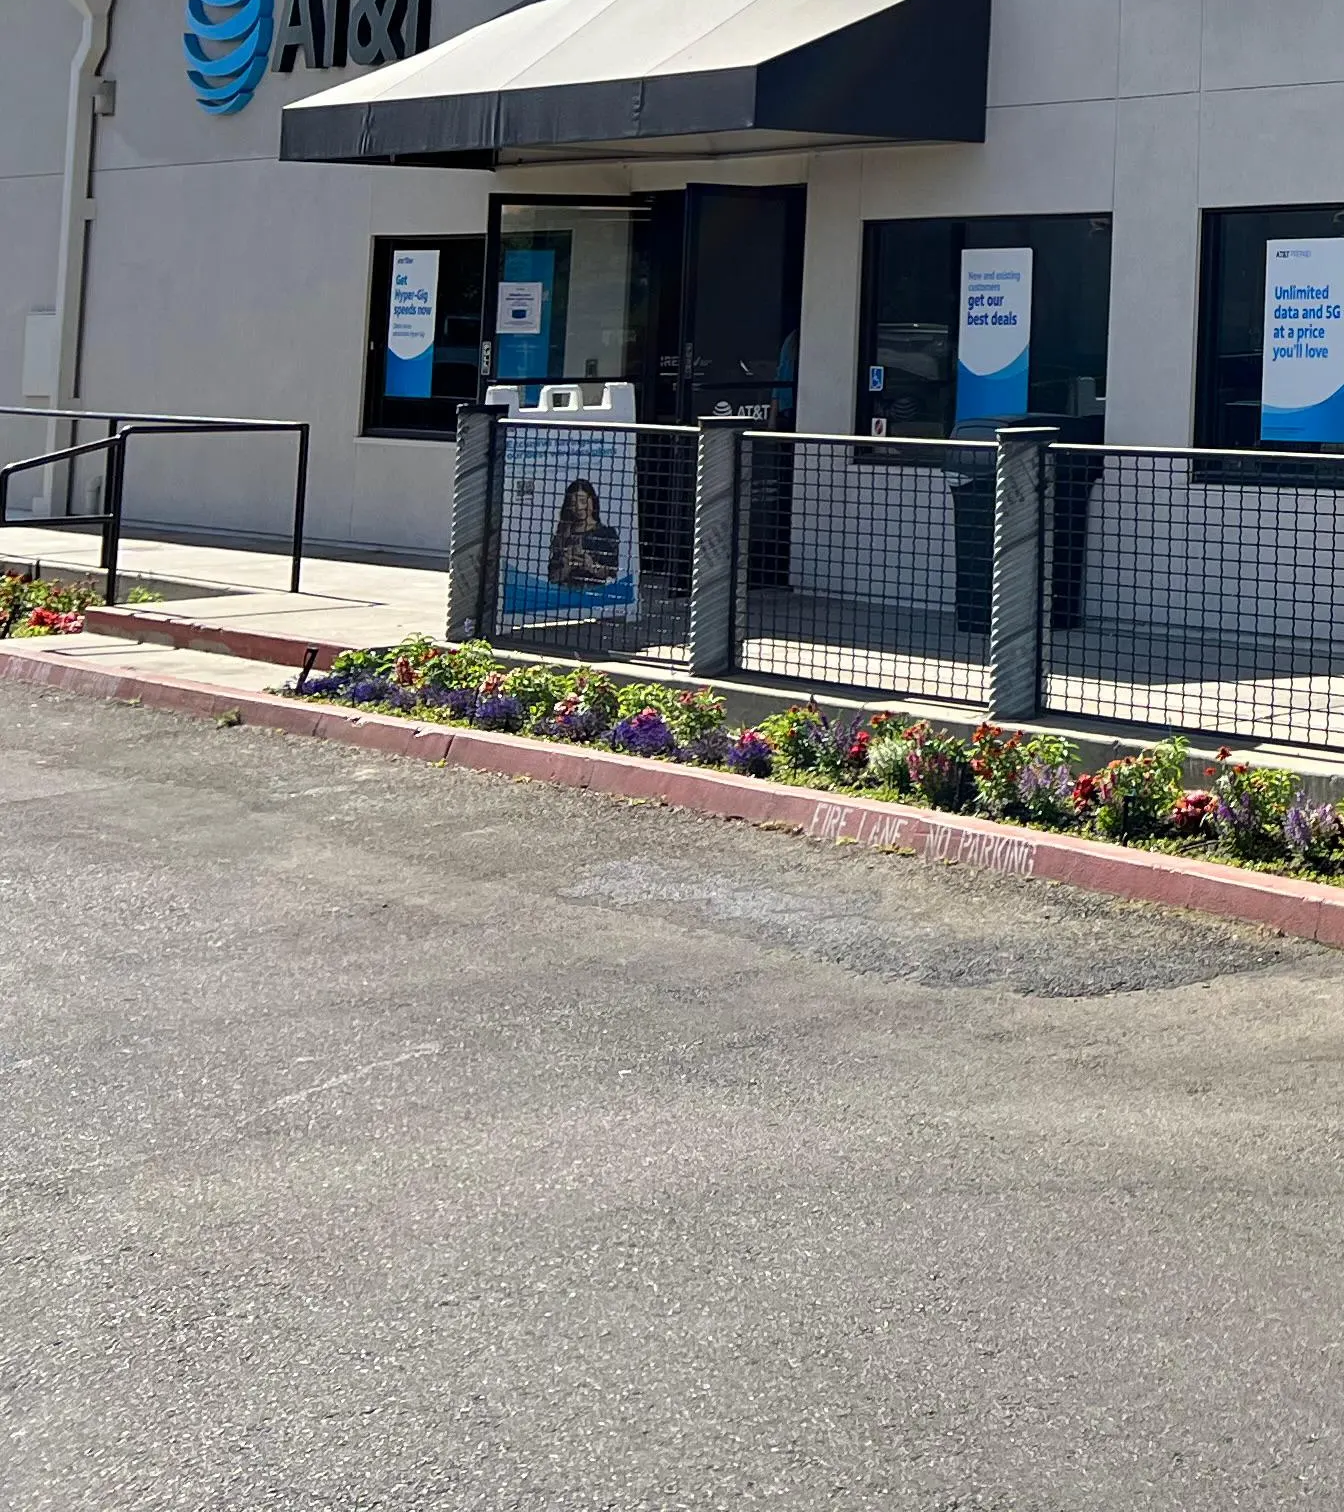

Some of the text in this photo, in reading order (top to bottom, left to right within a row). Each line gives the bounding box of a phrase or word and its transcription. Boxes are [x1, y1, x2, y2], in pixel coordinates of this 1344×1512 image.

[1274, 284, 1329, 300] Unlimited
[968, 293, 1005, 310] get our
[967, 310, 1018, 326] best deals
[1273, 304, 1341, 319] data and 5G
[1273, 323, 1325, 343] at a price
[1272, 343, 1329, 362] you'll love
[737, 404, 771, 421] AT&T
[810, 802, 1038, 876] FIRE LANE NO PARKING
